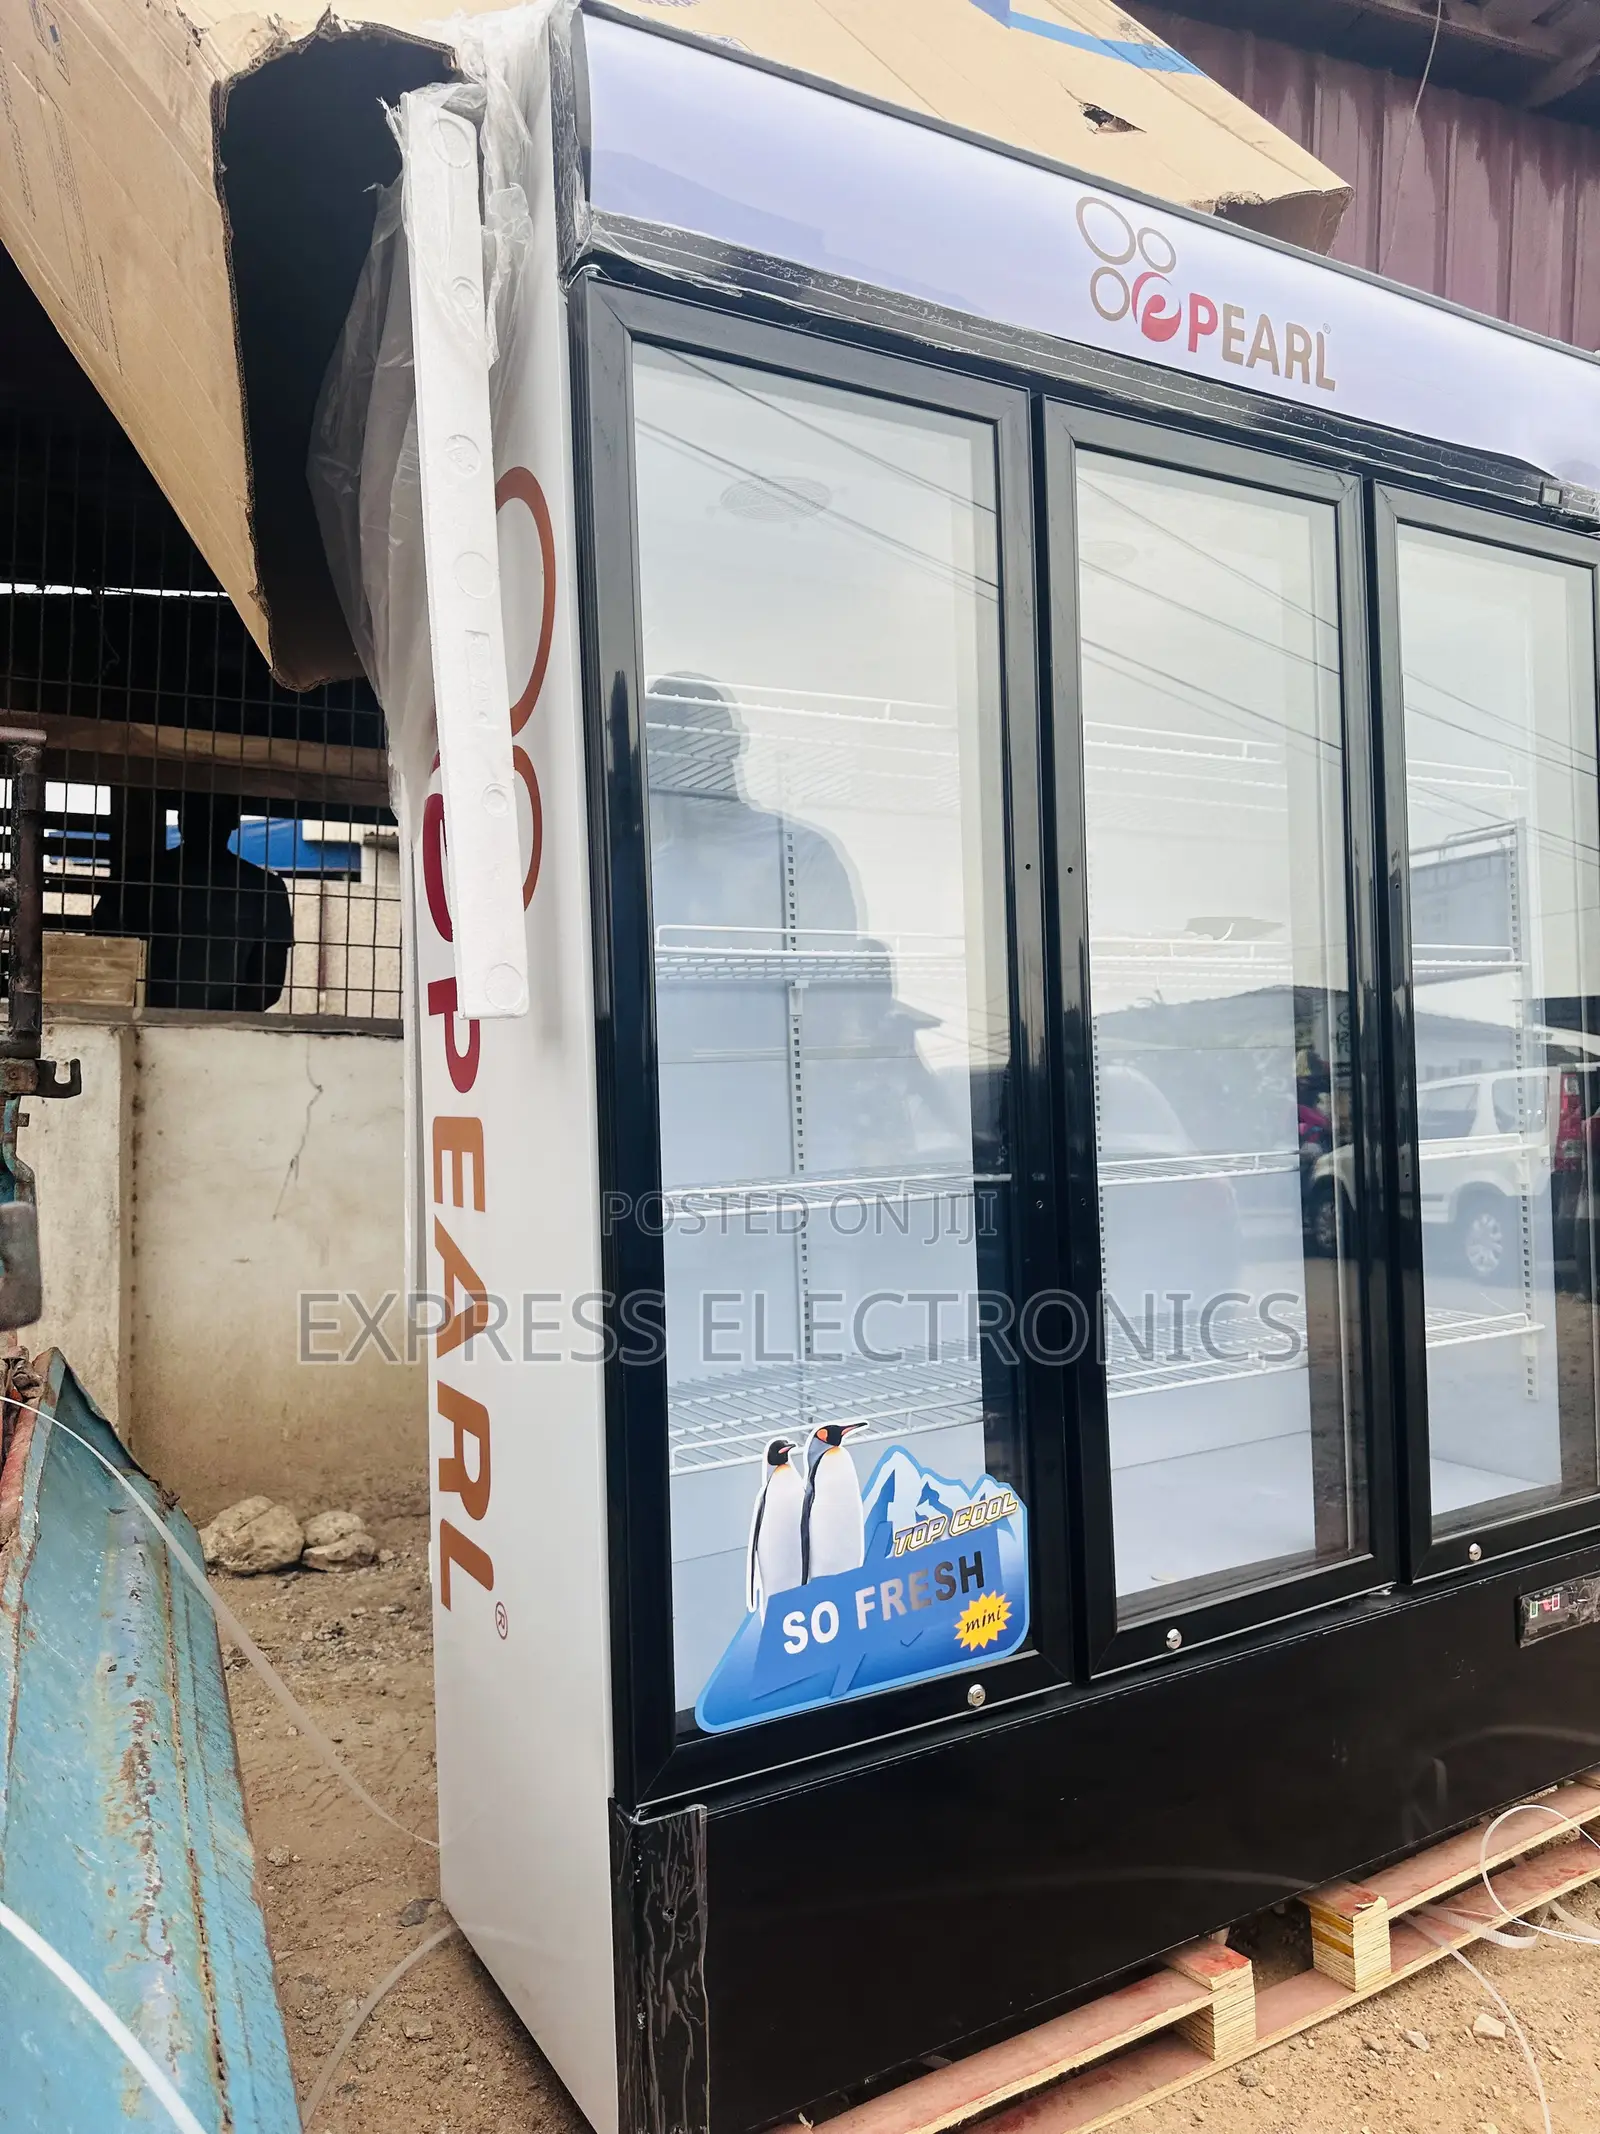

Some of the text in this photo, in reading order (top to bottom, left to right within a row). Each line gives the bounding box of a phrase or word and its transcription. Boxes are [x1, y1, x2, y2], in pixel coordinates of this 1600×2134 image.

[1187, 292, 1336, 392] PEARL
[894, 1492, 1018, 1557] TOP COOL
[782, 1550, 985, 1655] SO FRESH
[965, 1604, 1003, 1634] mini
